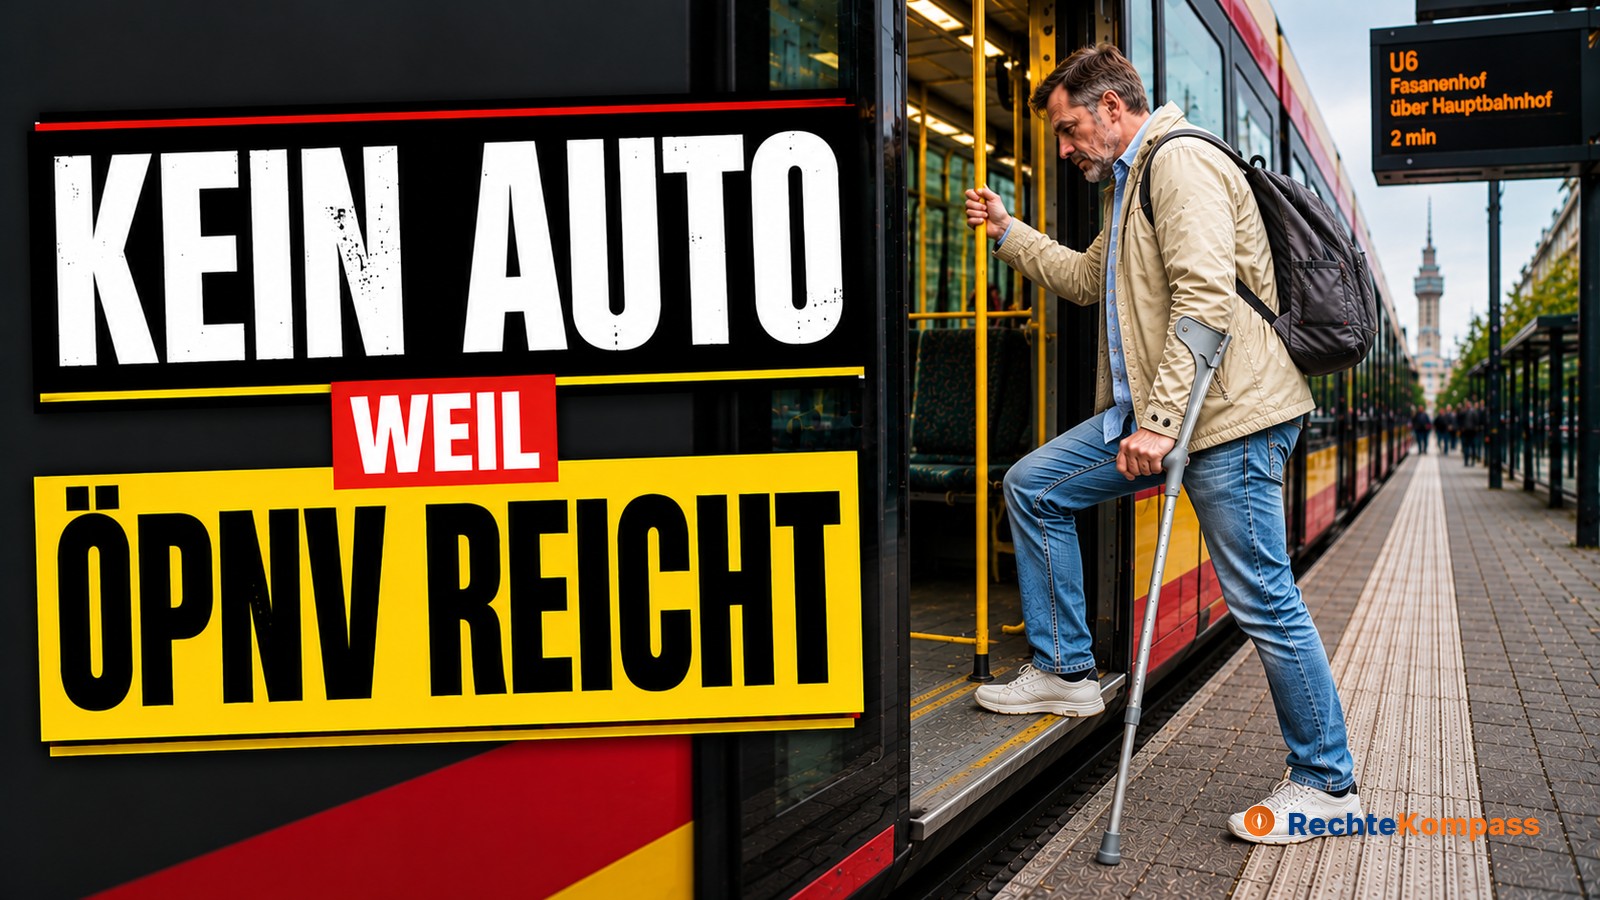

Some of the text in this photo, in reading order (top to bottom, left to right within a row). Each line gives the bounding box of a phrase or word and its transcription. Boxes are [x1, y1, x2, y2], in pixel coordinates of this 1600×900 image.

[1390, 50, 1419, 73] U6
[1390, 71, 1487, 95] Fasanenhof
[1390, 90, 1553, 117] über Hauptbahnhof
[1390, 128, 1437, 147] 2 min
